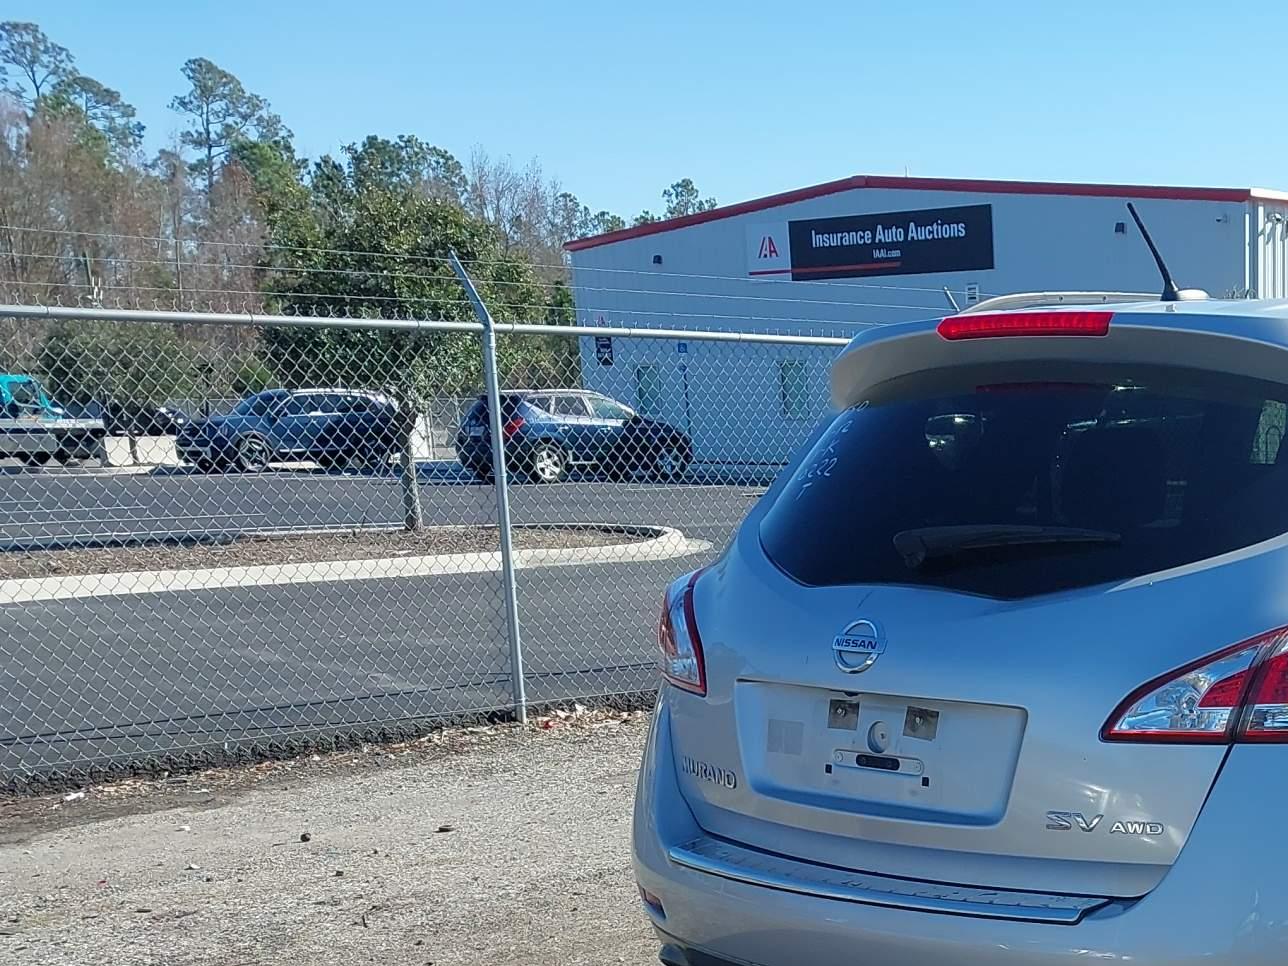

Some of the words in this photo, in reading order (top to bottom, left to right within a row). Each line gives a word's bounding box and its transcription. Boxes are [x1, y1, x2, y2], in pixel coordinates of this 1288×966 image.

[811, 229, 872, 248] Insurance
[875, 224, 904, 243] Auto
[908, 219, 966, 241] Auctions
[872, 247, 901, 259] IAAI.com
[834, 638, 878, 650] NISSAN
[682, 755, 737, 789] MURANO
[1046, 810, 1104, 832] SV
[1109, 820, 1164, 836] AWD
